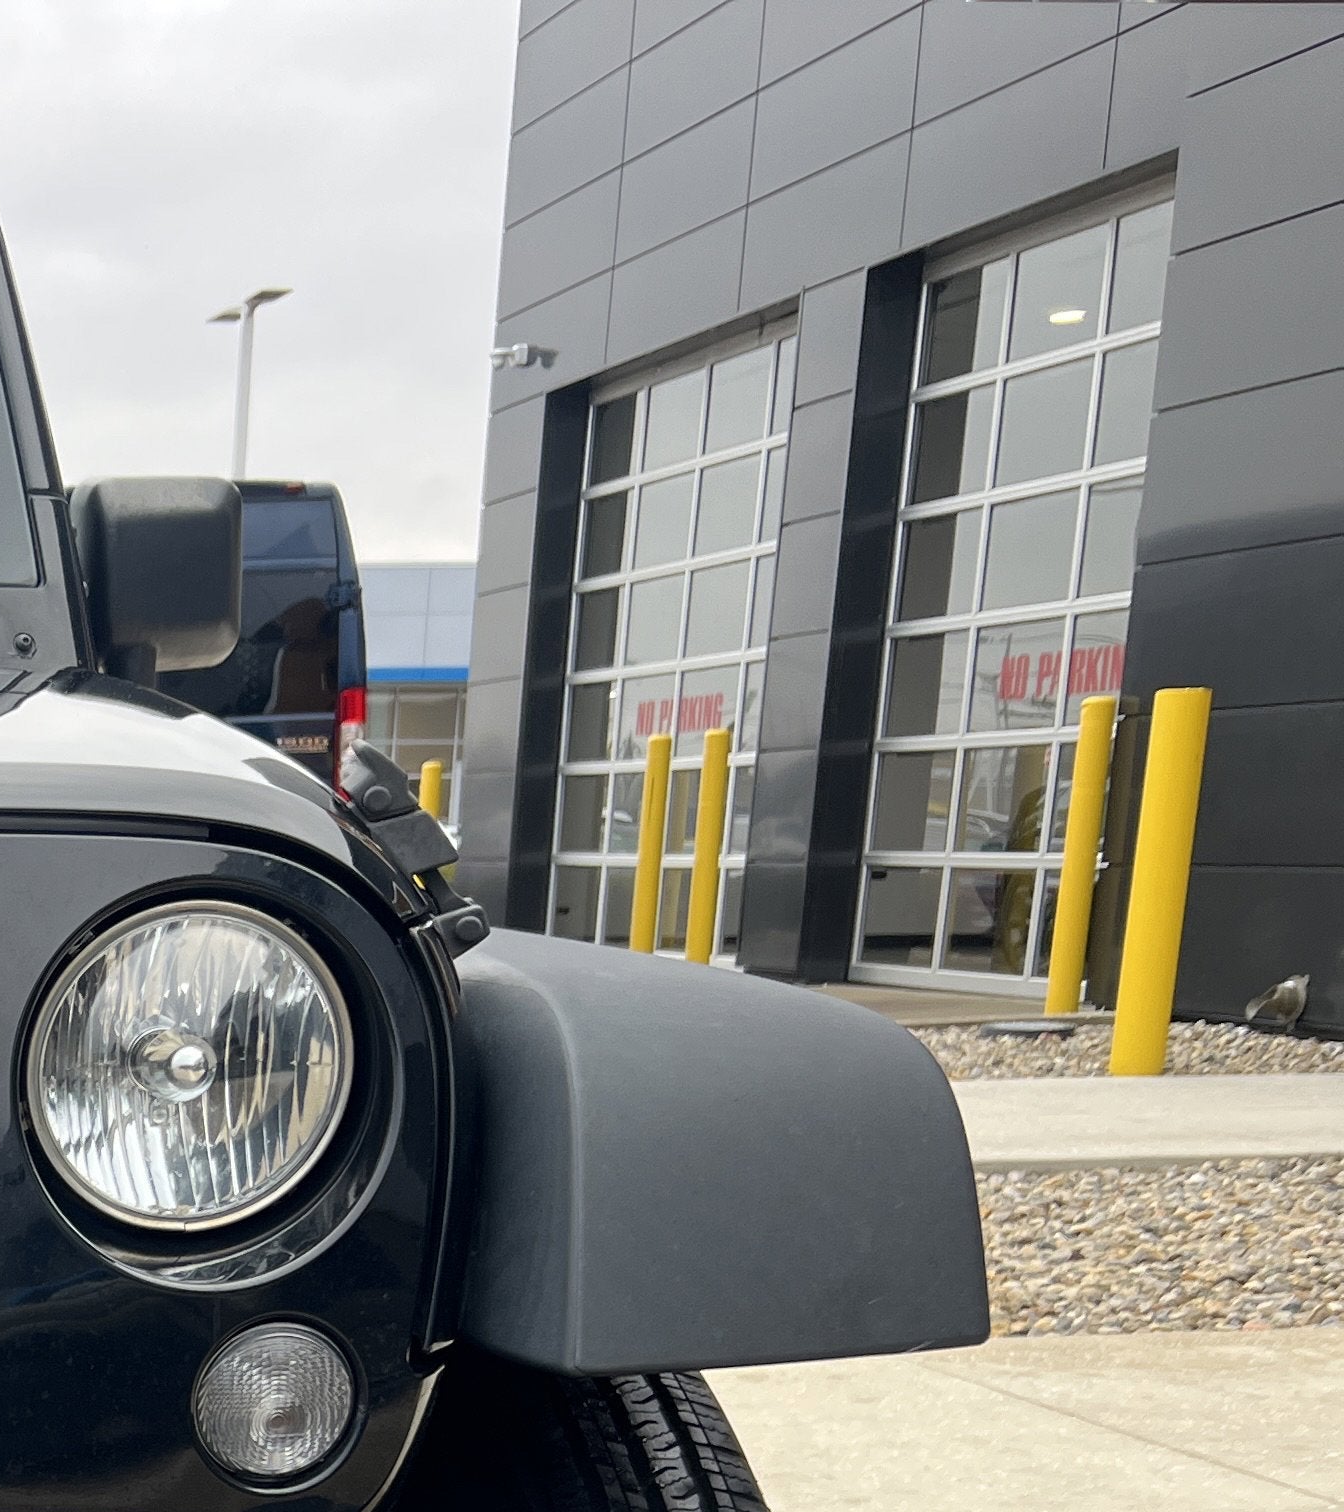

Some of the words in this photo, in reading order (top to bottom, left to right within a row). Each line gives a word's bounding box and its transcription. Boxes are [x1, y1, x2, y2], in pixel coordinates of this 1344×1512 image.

[999, 653, 1031, 702] NO
[1035, 641, 1127, 698] PARKIN
[635, 699, 656, 737] NO
